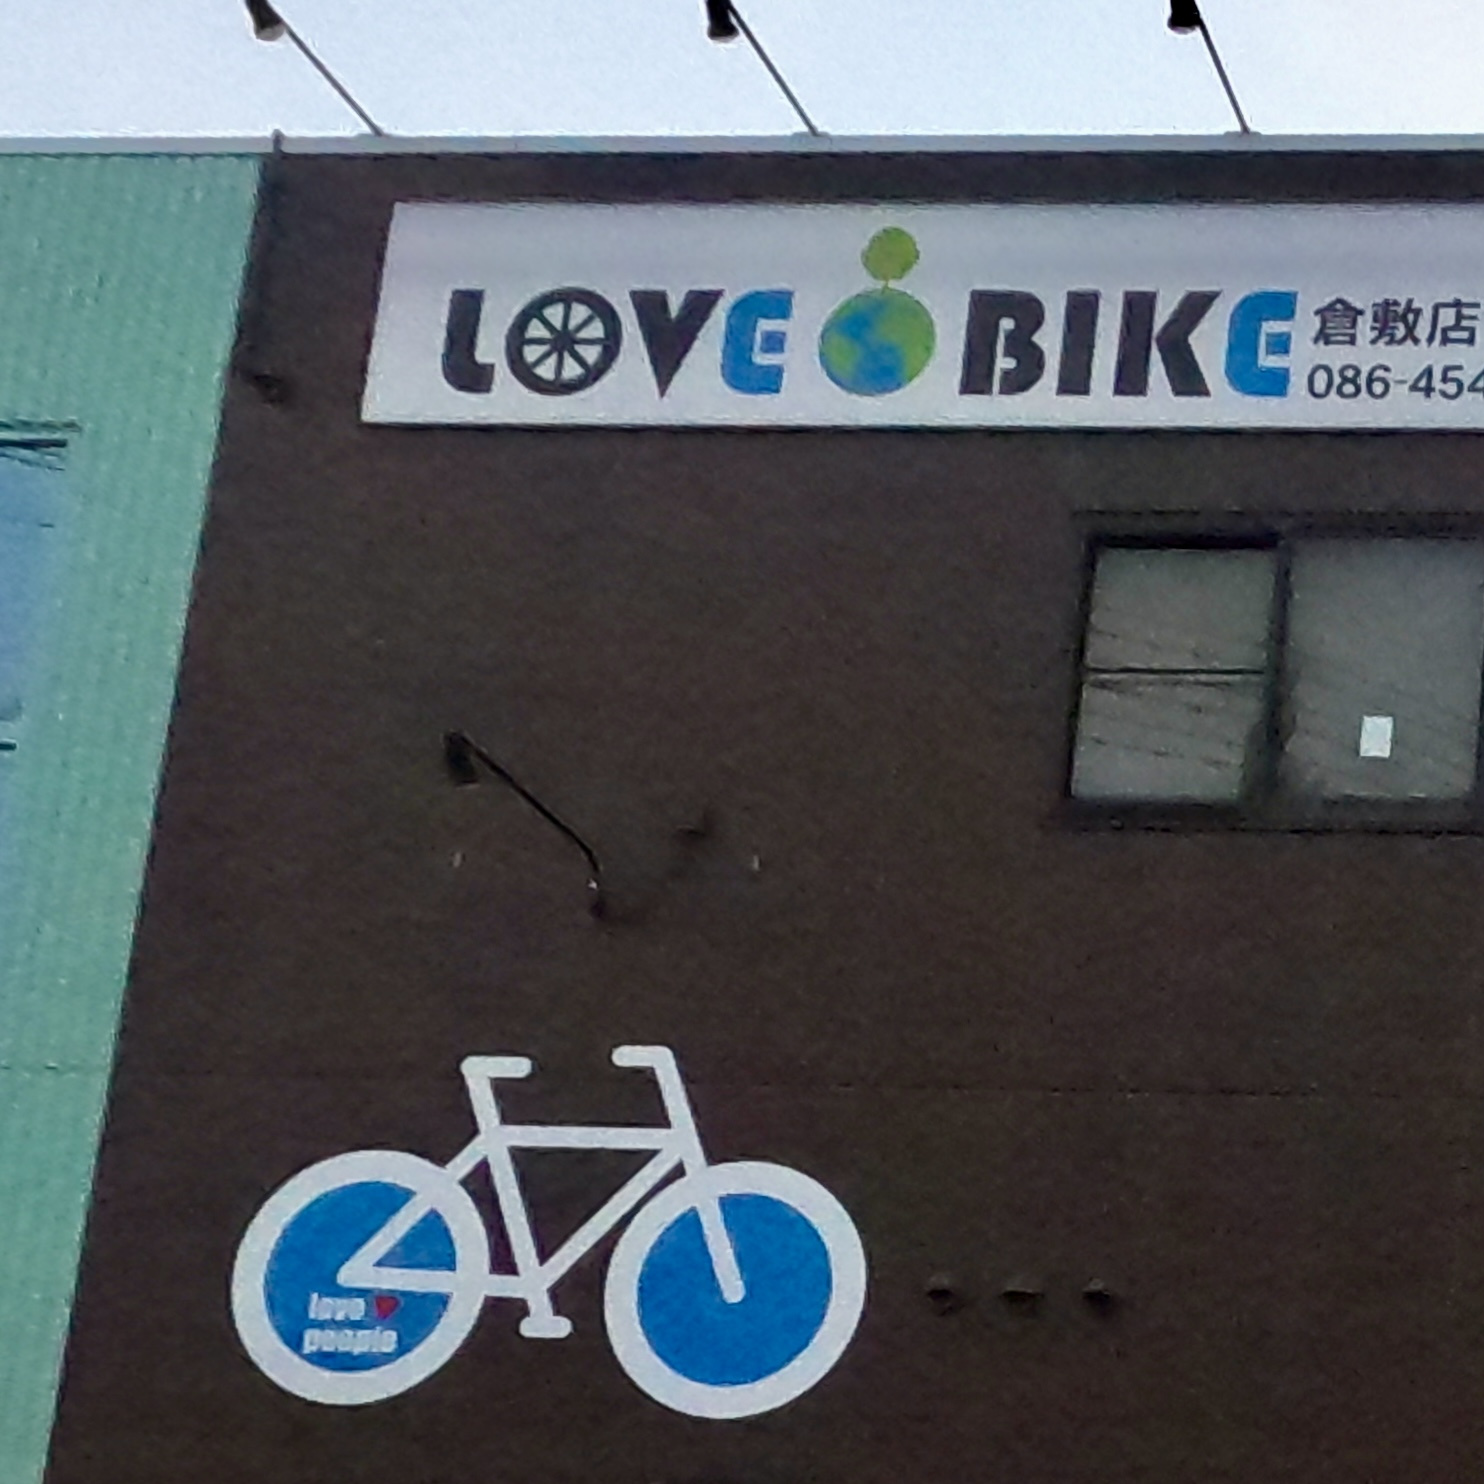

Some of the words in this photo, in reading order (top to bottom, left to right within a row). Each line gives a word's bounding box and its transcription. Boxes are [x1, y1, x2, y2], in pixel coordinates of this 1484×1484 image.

[441, 286, 795, 399] LOVE
[958, 289, 1298, 399] BIKE
[1312, 296, 1482, 349] 倉敷店
